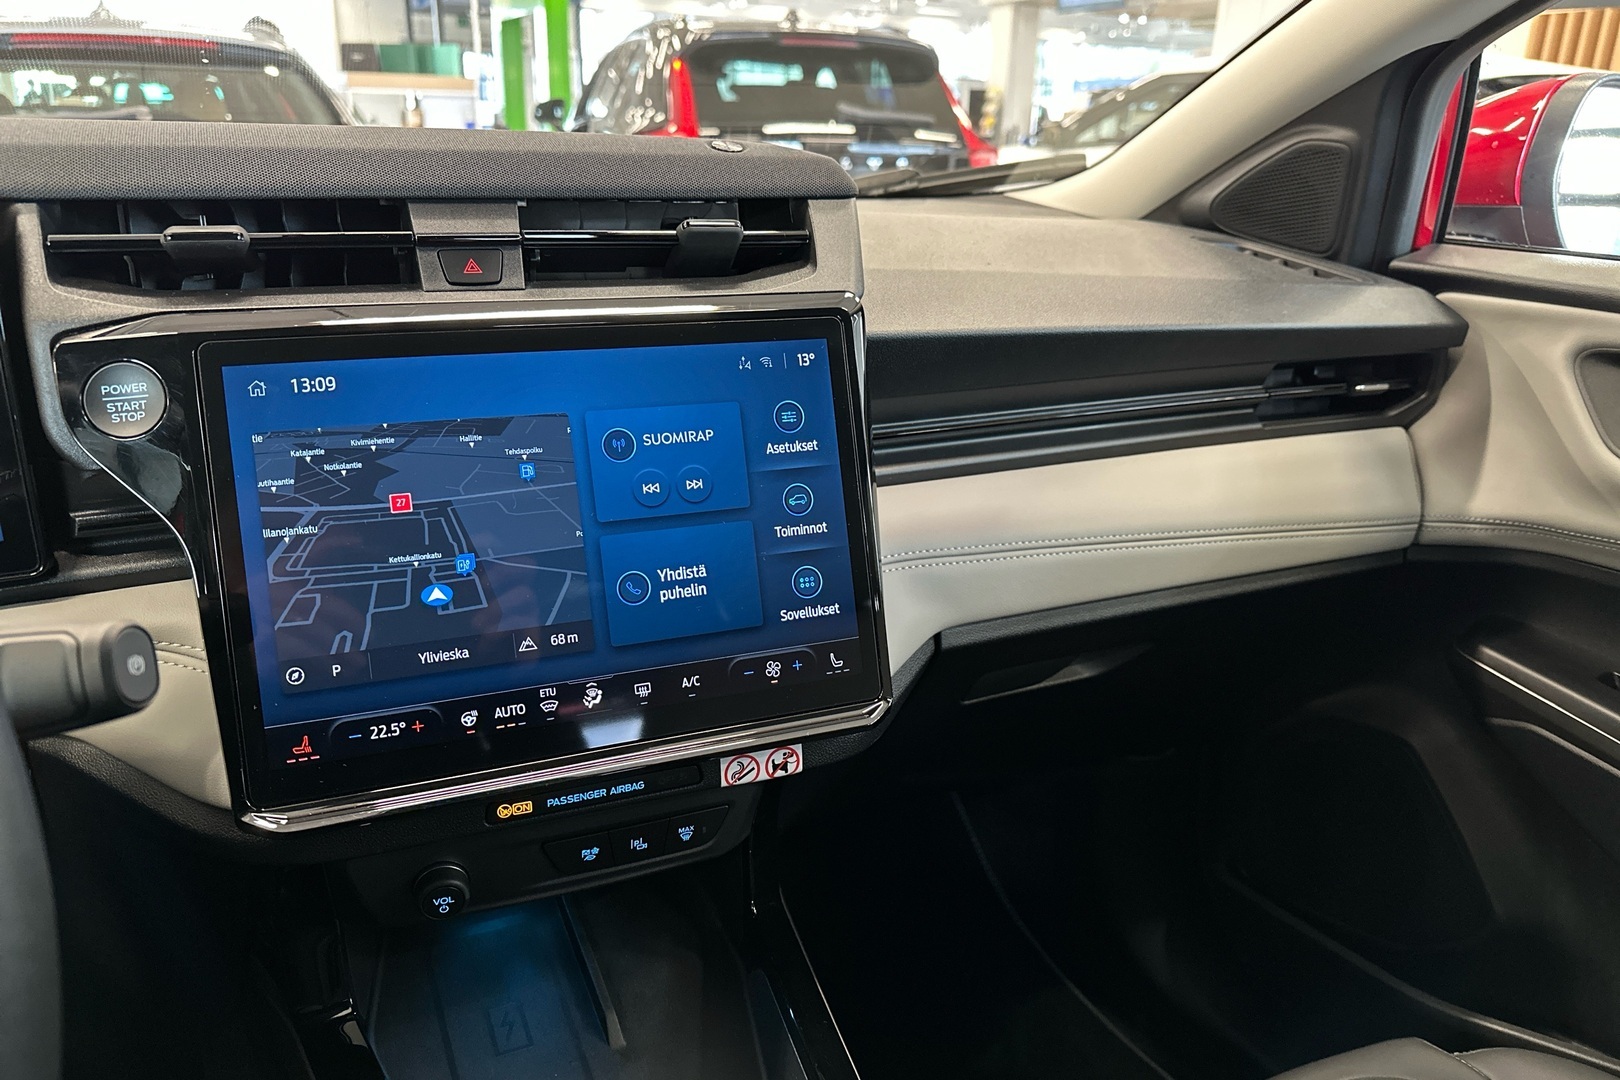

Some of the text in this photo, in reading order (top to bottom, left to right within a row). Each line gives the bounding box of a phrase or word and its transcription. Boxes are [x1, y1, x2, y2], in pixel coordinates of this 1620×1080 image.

[796, 352, 816, 367] 13°
[101, 382, 148, 395] POWER
[290, 376, 336, 394] 13:09
[106, 400, 147, 412] START
[112, 411, 146, 423] STOP
[642, 429, 714, 446] SUOMIRAP
[290, 448, 325, 458] Katajantie
[766, 439, 818, 454] Asetukset
[324, 462, 362, 472] Notkolantie
[774, 521, 828, 538] Toiminnot
[388, 552, 442, 564] Kettukallionkatu
[656, 564, 708, 582] Yhdistä
[660, 583, 708, 604] puhelin
[780, 602, 840, 622] Sovellukset
[550, 632, 579, 646] 68 m
[418, 648, 470, 664] Ylivieska
[682, 675, 701, 688] A/C
[539, 687, 556, 698] ETU
[494, 703, 526, 719] AUTO
[370, 721, 406, 740] 22.5°
[547, 780, 645, 808] PASSENGER AIRBAG
[514, 803, 530, 814] ON
[678, 825, 694, 834] MAX
[432, 896, 455, 906] VOL
